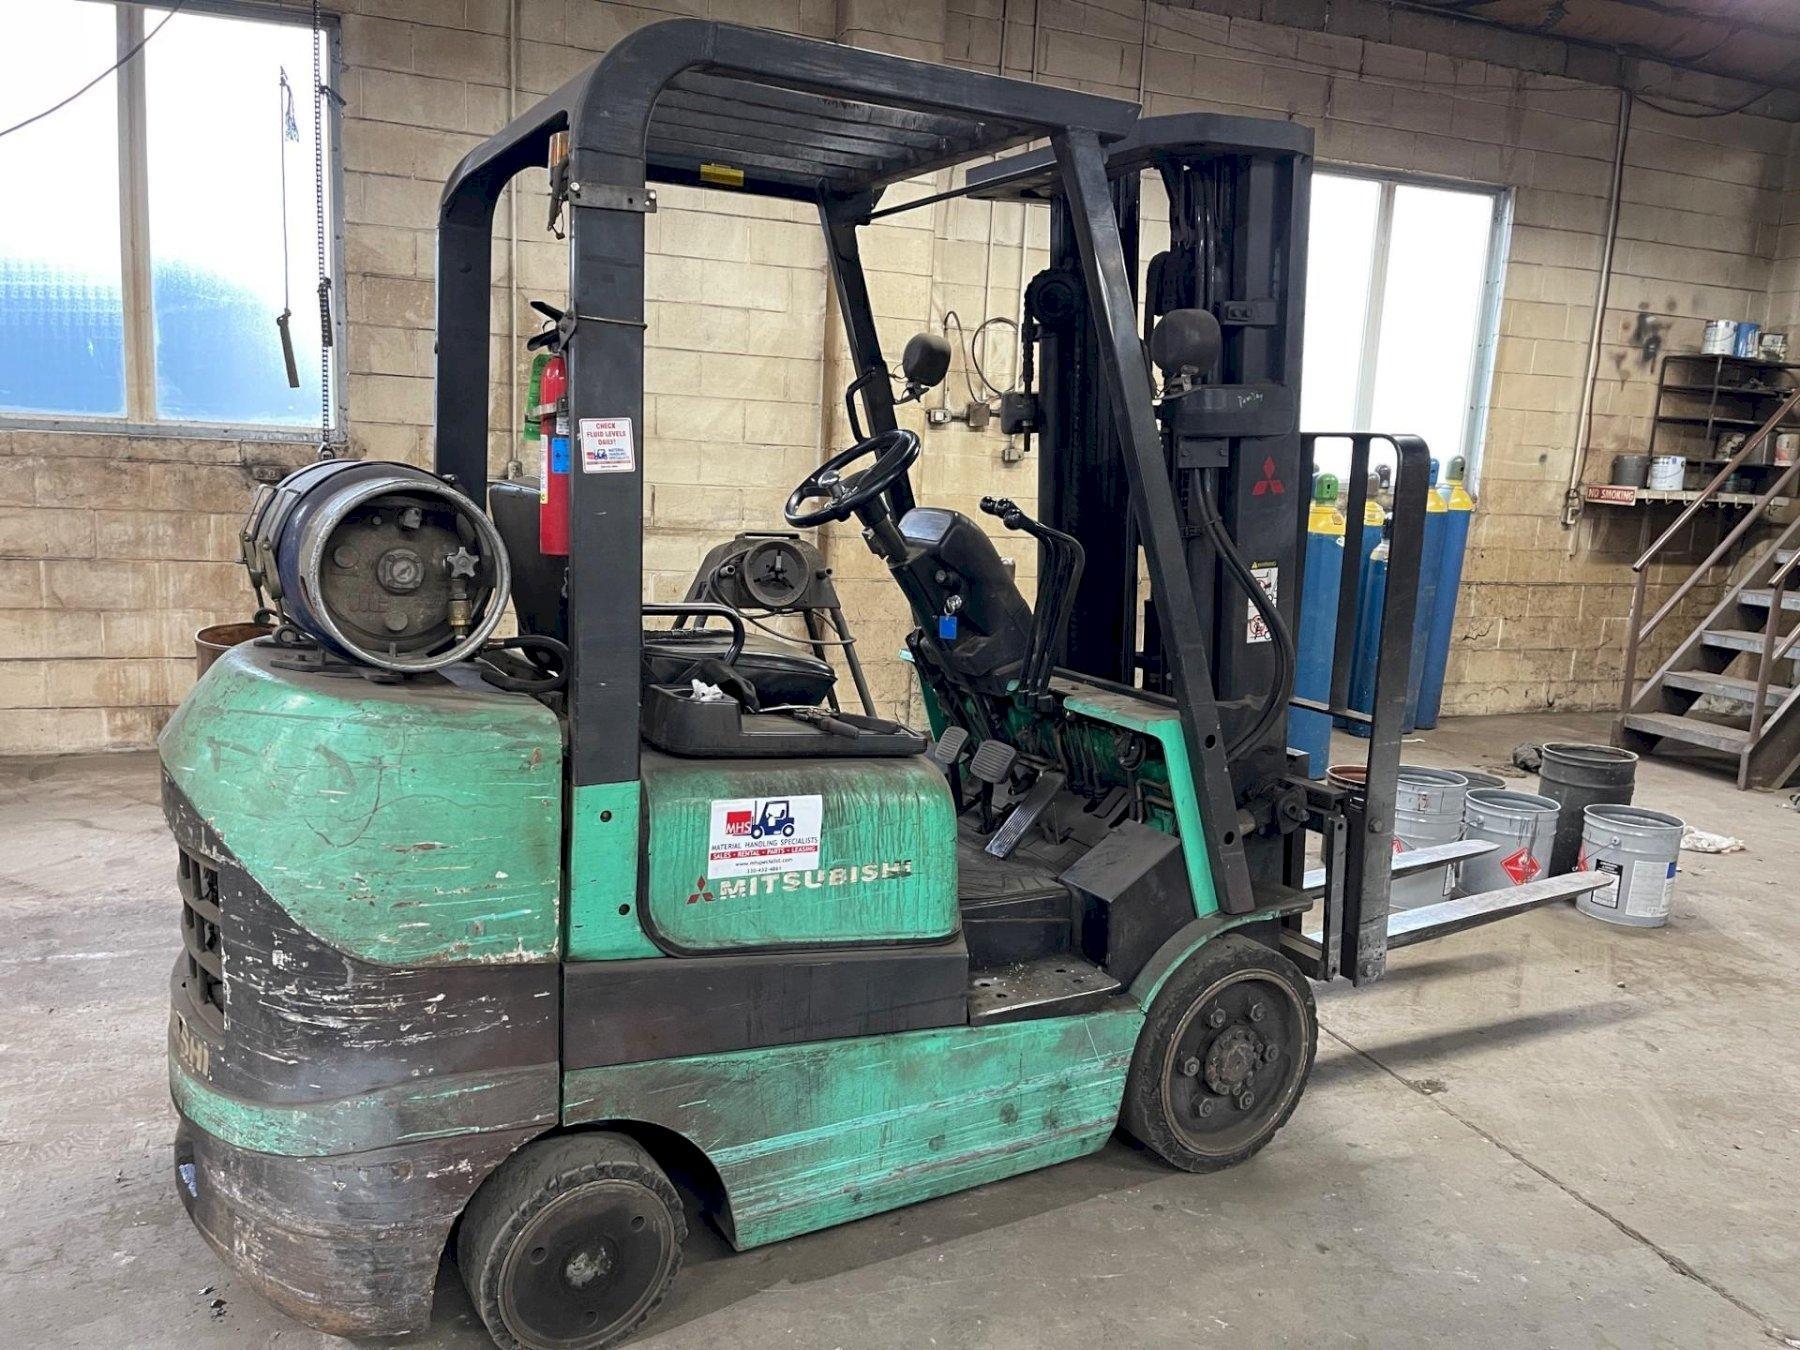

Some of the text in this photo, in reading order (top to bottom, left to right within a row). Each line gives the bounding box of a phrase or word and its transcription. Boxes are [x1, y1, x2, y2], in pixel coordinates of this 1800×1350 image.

[1588, 488, 1635, 501] NO SMOKING
[725, 821, 752, 835] MHS
[711, 836, 818, 851] MATERIAL HANDLING SPECIALISTS
[713, 845, 816, 860] SALES RENTAL PARTS LEASING
[719, 859, 912, 900] MITSUBISHI
